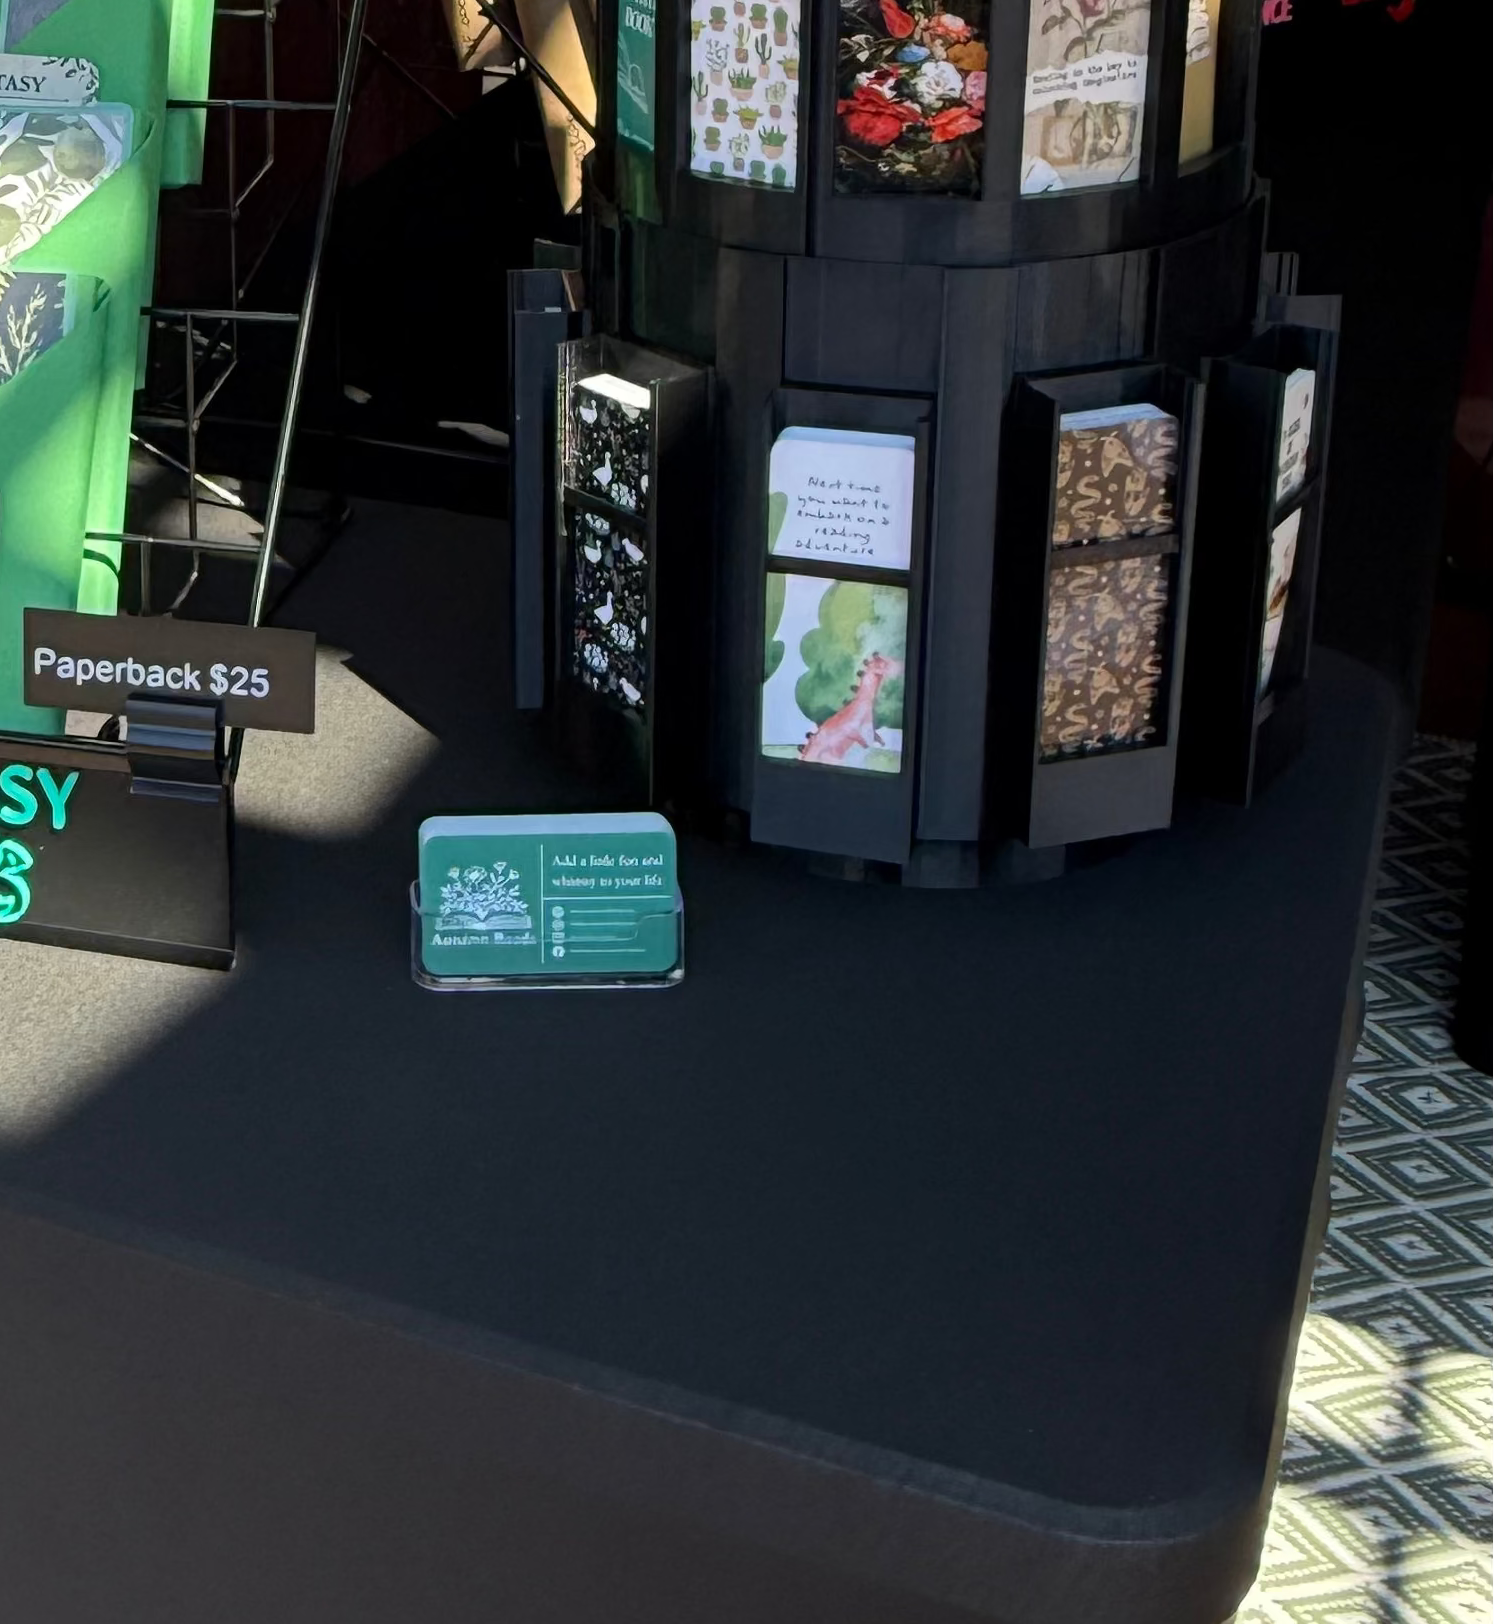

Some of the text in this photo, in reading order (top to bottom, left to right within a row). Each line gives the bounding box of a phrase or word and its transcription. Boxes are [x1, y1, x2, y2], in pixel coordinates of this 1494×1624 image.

[807, 476, 842, 490] Next
[797, 495, 826, 508] you
[814, 527, 871, 546] reading
[33, 646, 271, 700] Paperback $25
